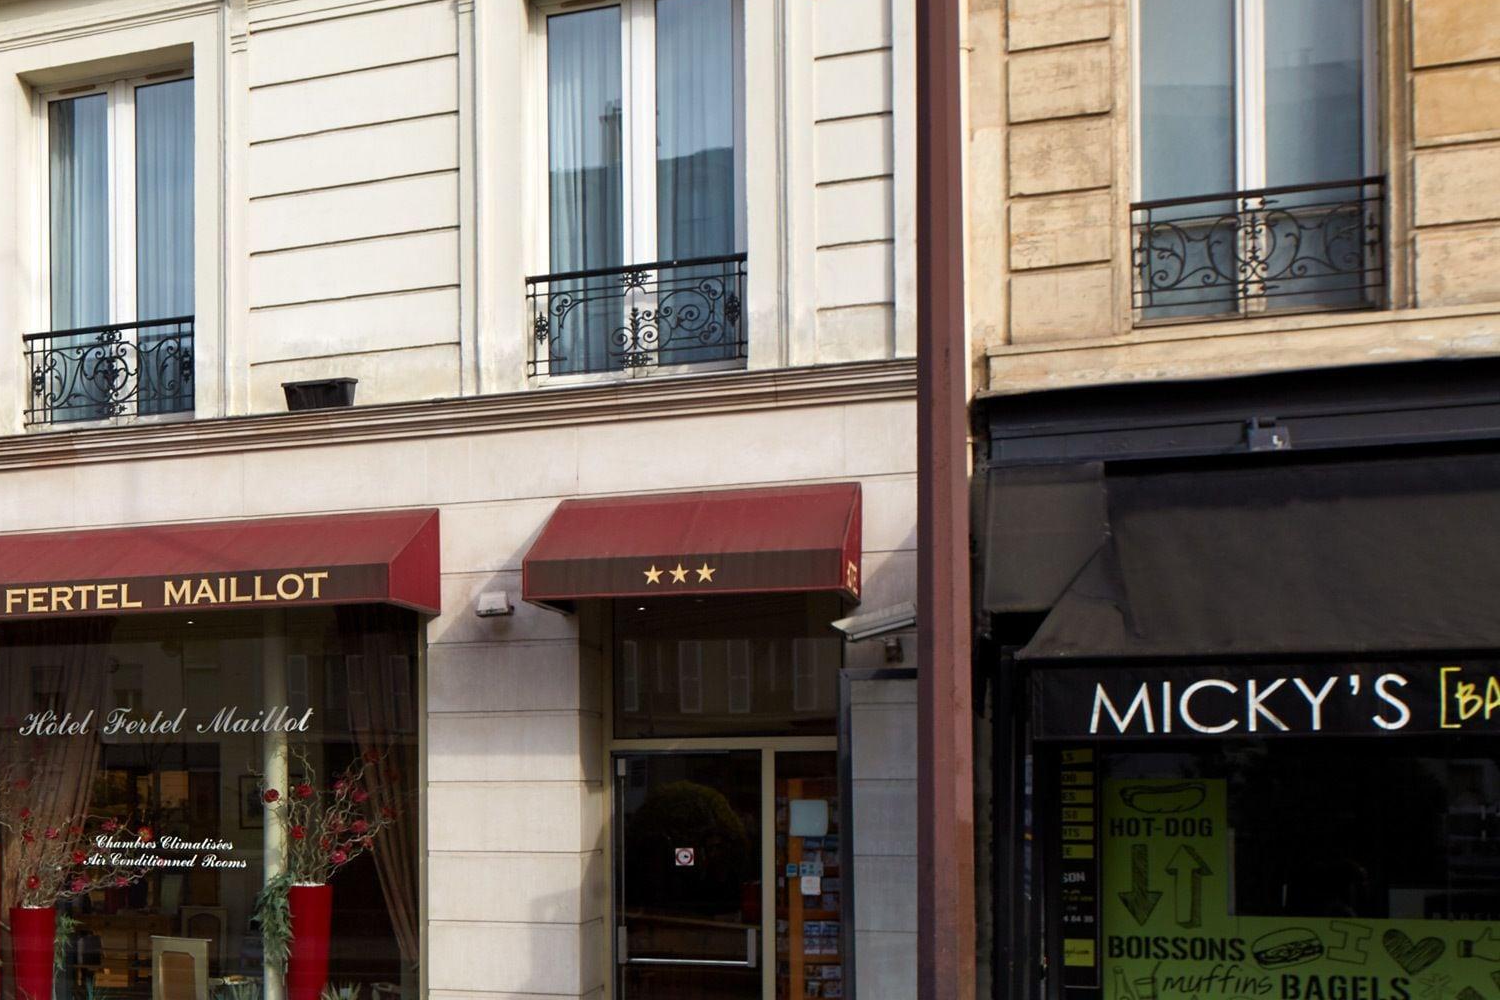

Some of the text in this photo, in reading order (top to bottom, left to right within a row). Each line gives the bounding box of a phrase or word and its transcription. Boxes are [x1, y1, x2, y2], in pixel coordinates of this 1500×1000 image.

[5, 583, 143, 614] FERTEL
[163, 572, 329, 605] MAILLOT
[1089, 673, 1411, 734] MICKY'S
[18, 705, 315, 736] Hôtel Fertel Maillot
[1109, 817, 1213, 837] HOT-DOG
[94, 835, 233, 850] Chambres Climatisées
[83, 852, 247, 868] Air Conditionned Rooms
[1108, 935, 1246, 961] BOISSONS
[1162, 964, 1273, 995] muffins
[1280, 974, 1411, 1000] BAGELS
